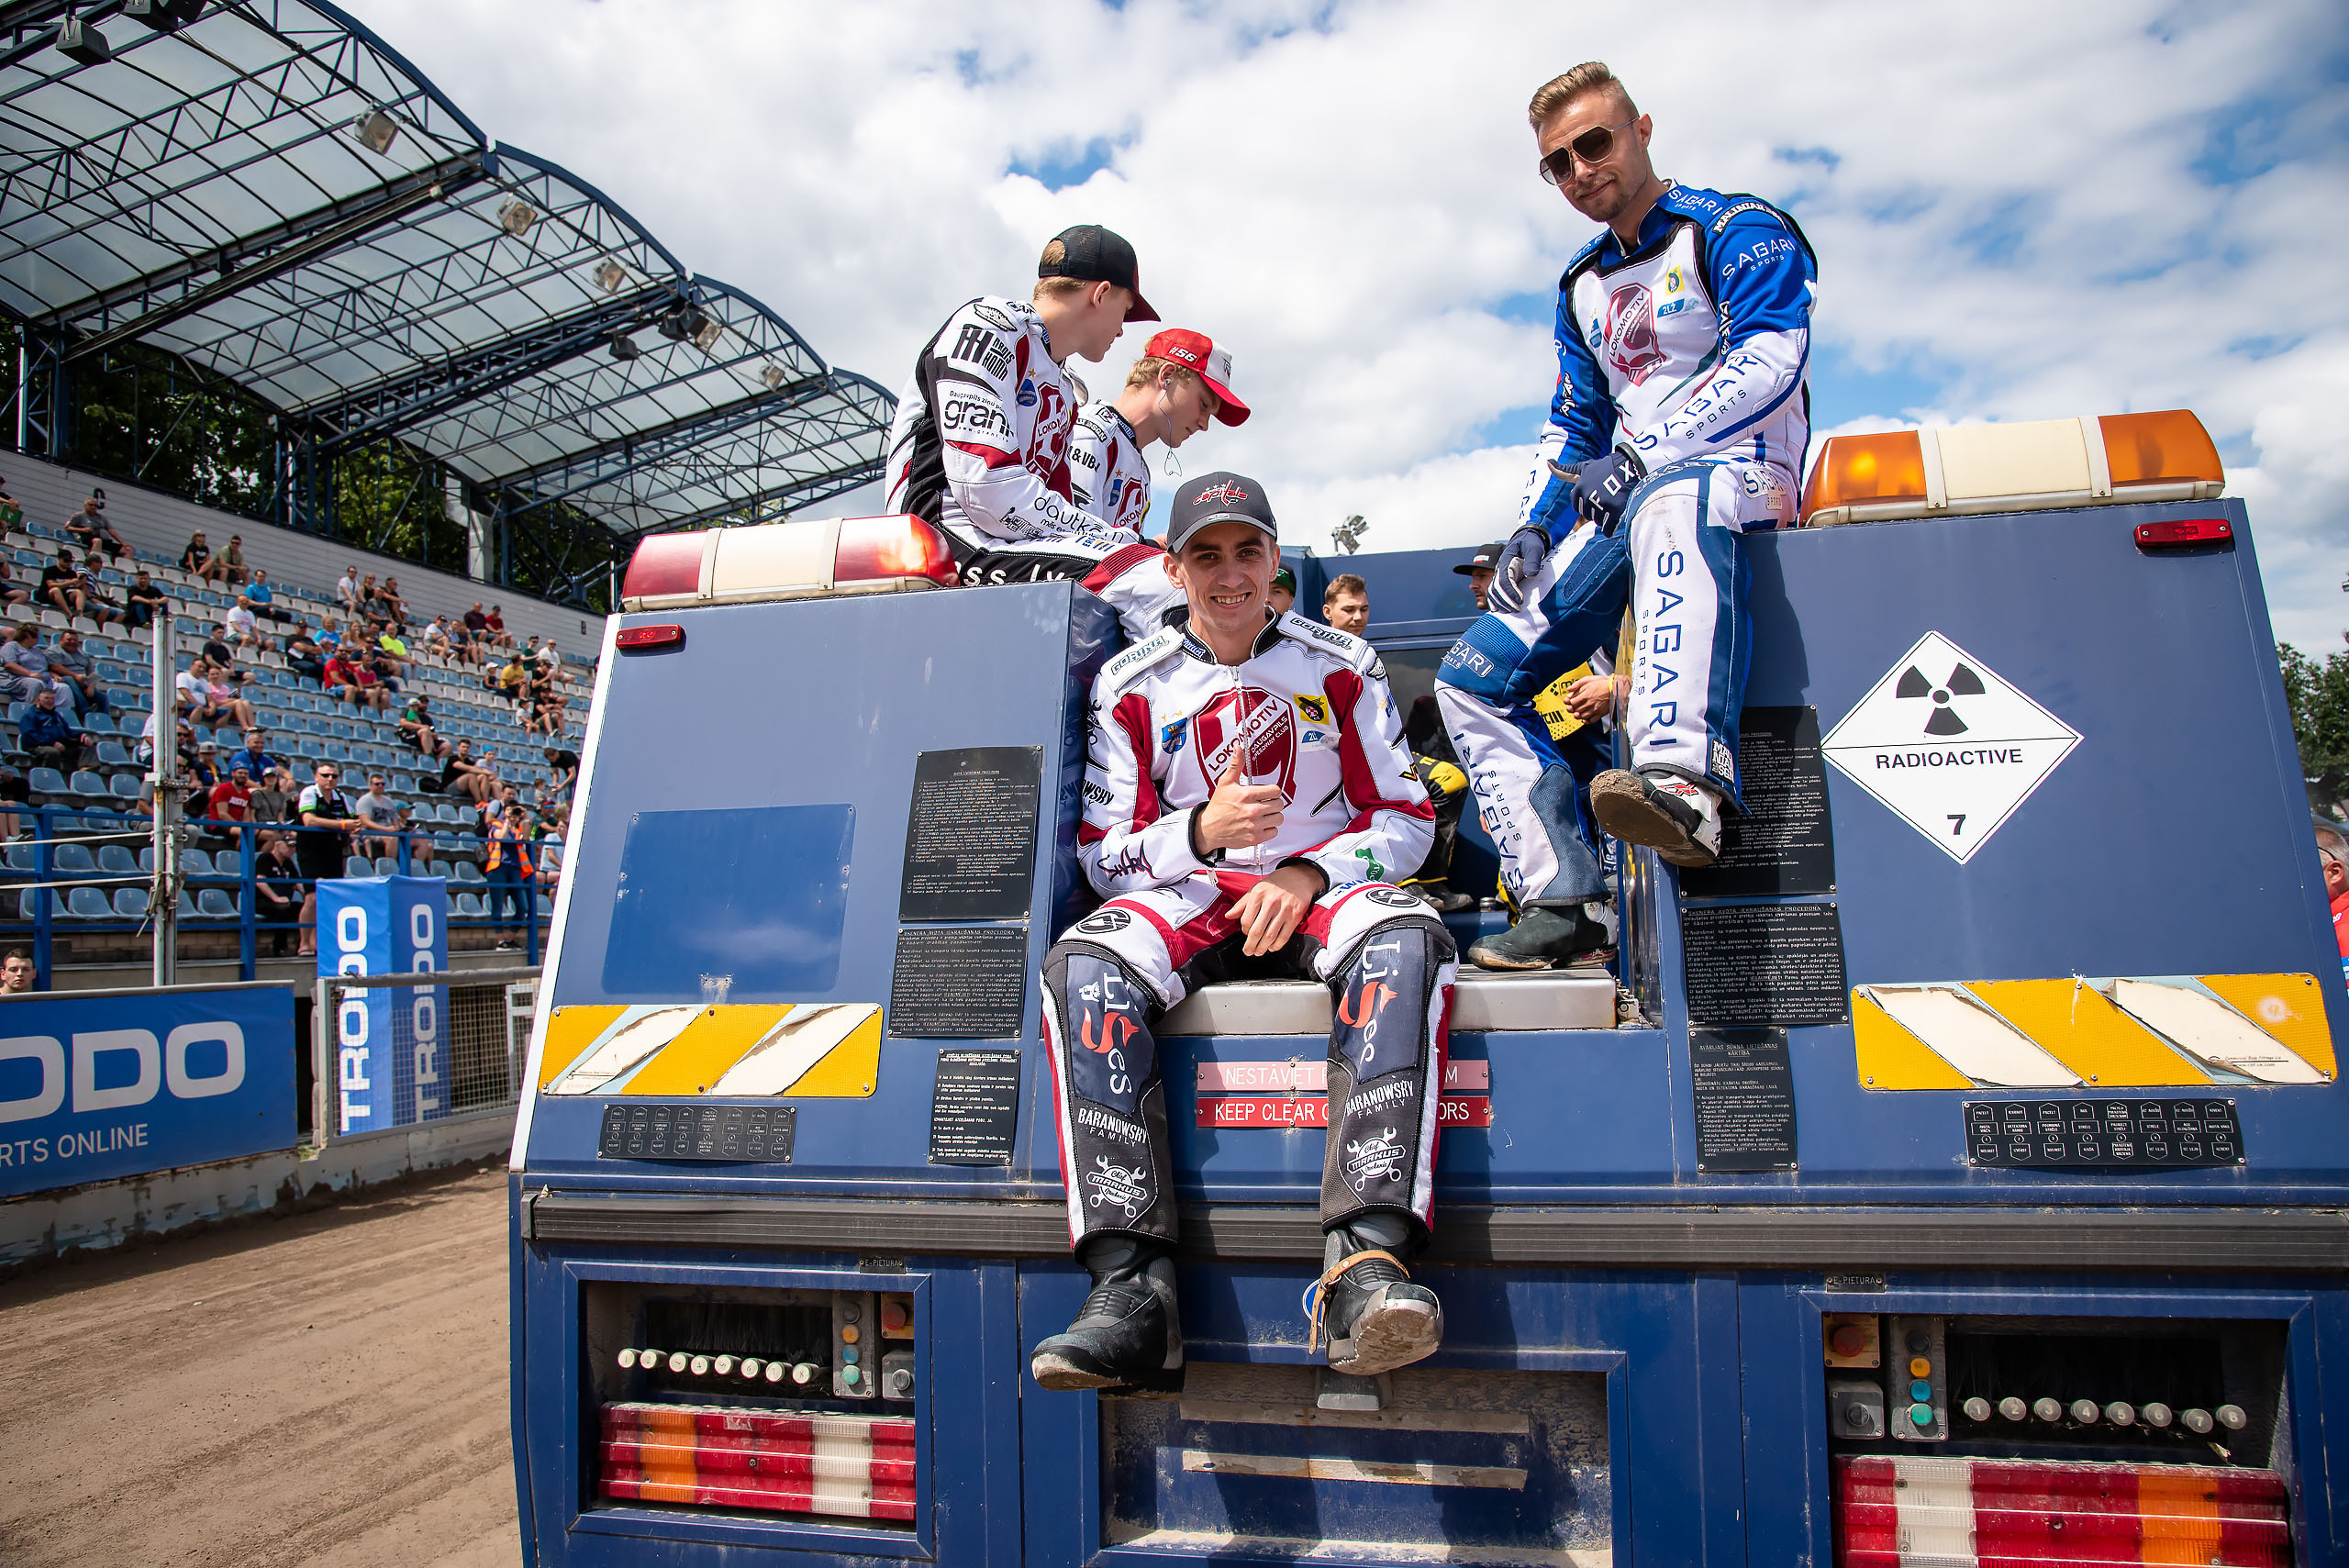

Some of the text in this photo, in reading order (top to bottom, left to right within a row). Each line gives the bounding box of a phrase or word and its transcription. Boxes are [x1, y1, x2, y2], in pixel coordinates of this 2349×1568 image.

[1668, 189, 1723, 216] SAGARI
[1722, 239, 1796, 281] SAGARI
[1750, 254, 1785, 271] SPORTS
[1609, 292, 1644, 357] LOKOMOTIV
[1168, 346, 1197, 363] #56
[1686, 389, 1747, 439] SPORTS
[1588, 460, 1635, 510] FOX
[1451, 641, 1492, 676] GARI
[1638, 610, 1649, 695] SPORTS
[1650, 550, 1684, 746] SAGARI
[1208, 699, 1279, 772] LOKOMOTIV
[1251, 716, 1288, 753] DAUGAVPILS
[1275, 725, 1289, 739] CLUB
[1876, 749, 2023, 769] RADIOACTIVE
[1453, 733, 1524, 891] SAGARI
[1488, 770, 1522, 842] SPORTS
[1947, 814, 1966, 836] 7
[337, 906, 371, 1132] TRODO
[411, 904, 440, 1123] TRODO
[0, 1021, 246, 1123] ODO
[1225, 1063, 1312, 1085] NESTĀVIET
[1215, 1106, 1256, 1121] KEEP
[1262, 1105, 1315, 1121] CLEAR
[1440, 1108, 1470, 1121] ORS
[1357, 1098, 1406, 1118] FAMILY
[0, 1123, 149, 1168] RTS ONLINE
[1089, 1127, 1136, 1147] FAMILY
[1352, 1149, 1400, 1171] MARKUS
[1092, 1176, 1141, 1196] MARKUS
[1833, 1276, 1875, 1284] E-PIETURA
[2011, 1406, 2020, 1415] 2
[2082, 1406, 2091, 1417] 4
[2118, 1408, 2126, 1419] 5
[2155, 1410, 2164, 1420] 6
[2196, 1416, 2204, 1427] 7
